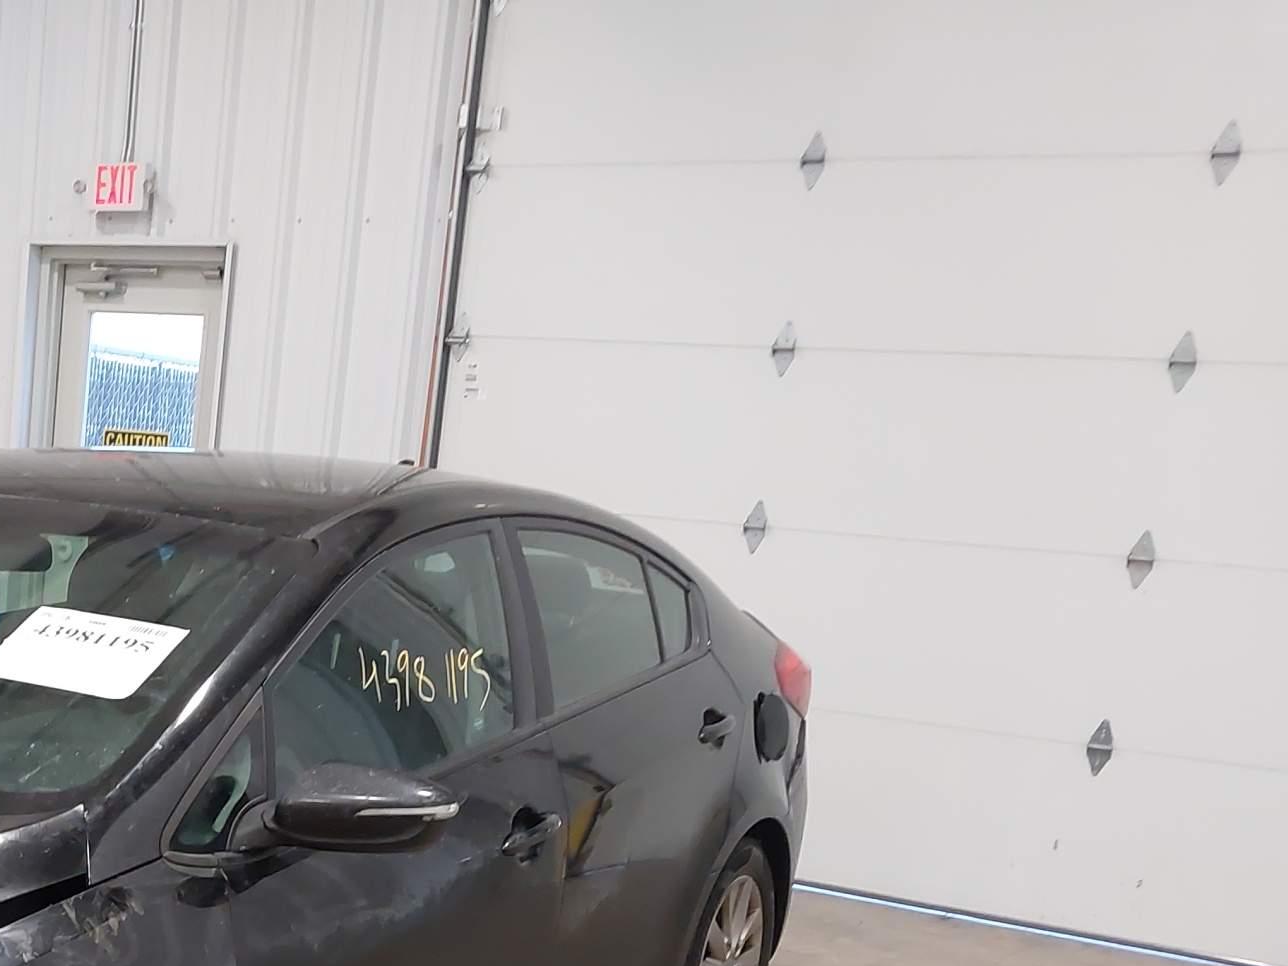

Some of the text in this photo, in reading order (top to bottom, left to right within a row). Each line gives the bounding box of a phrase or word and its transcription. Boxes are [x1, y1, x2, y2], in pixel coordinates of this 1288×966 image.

[95, 164, 137, 205] EXIT
[105, 432, 168, 447] CAUTION
[33, 623, 155, 653] 43981195
